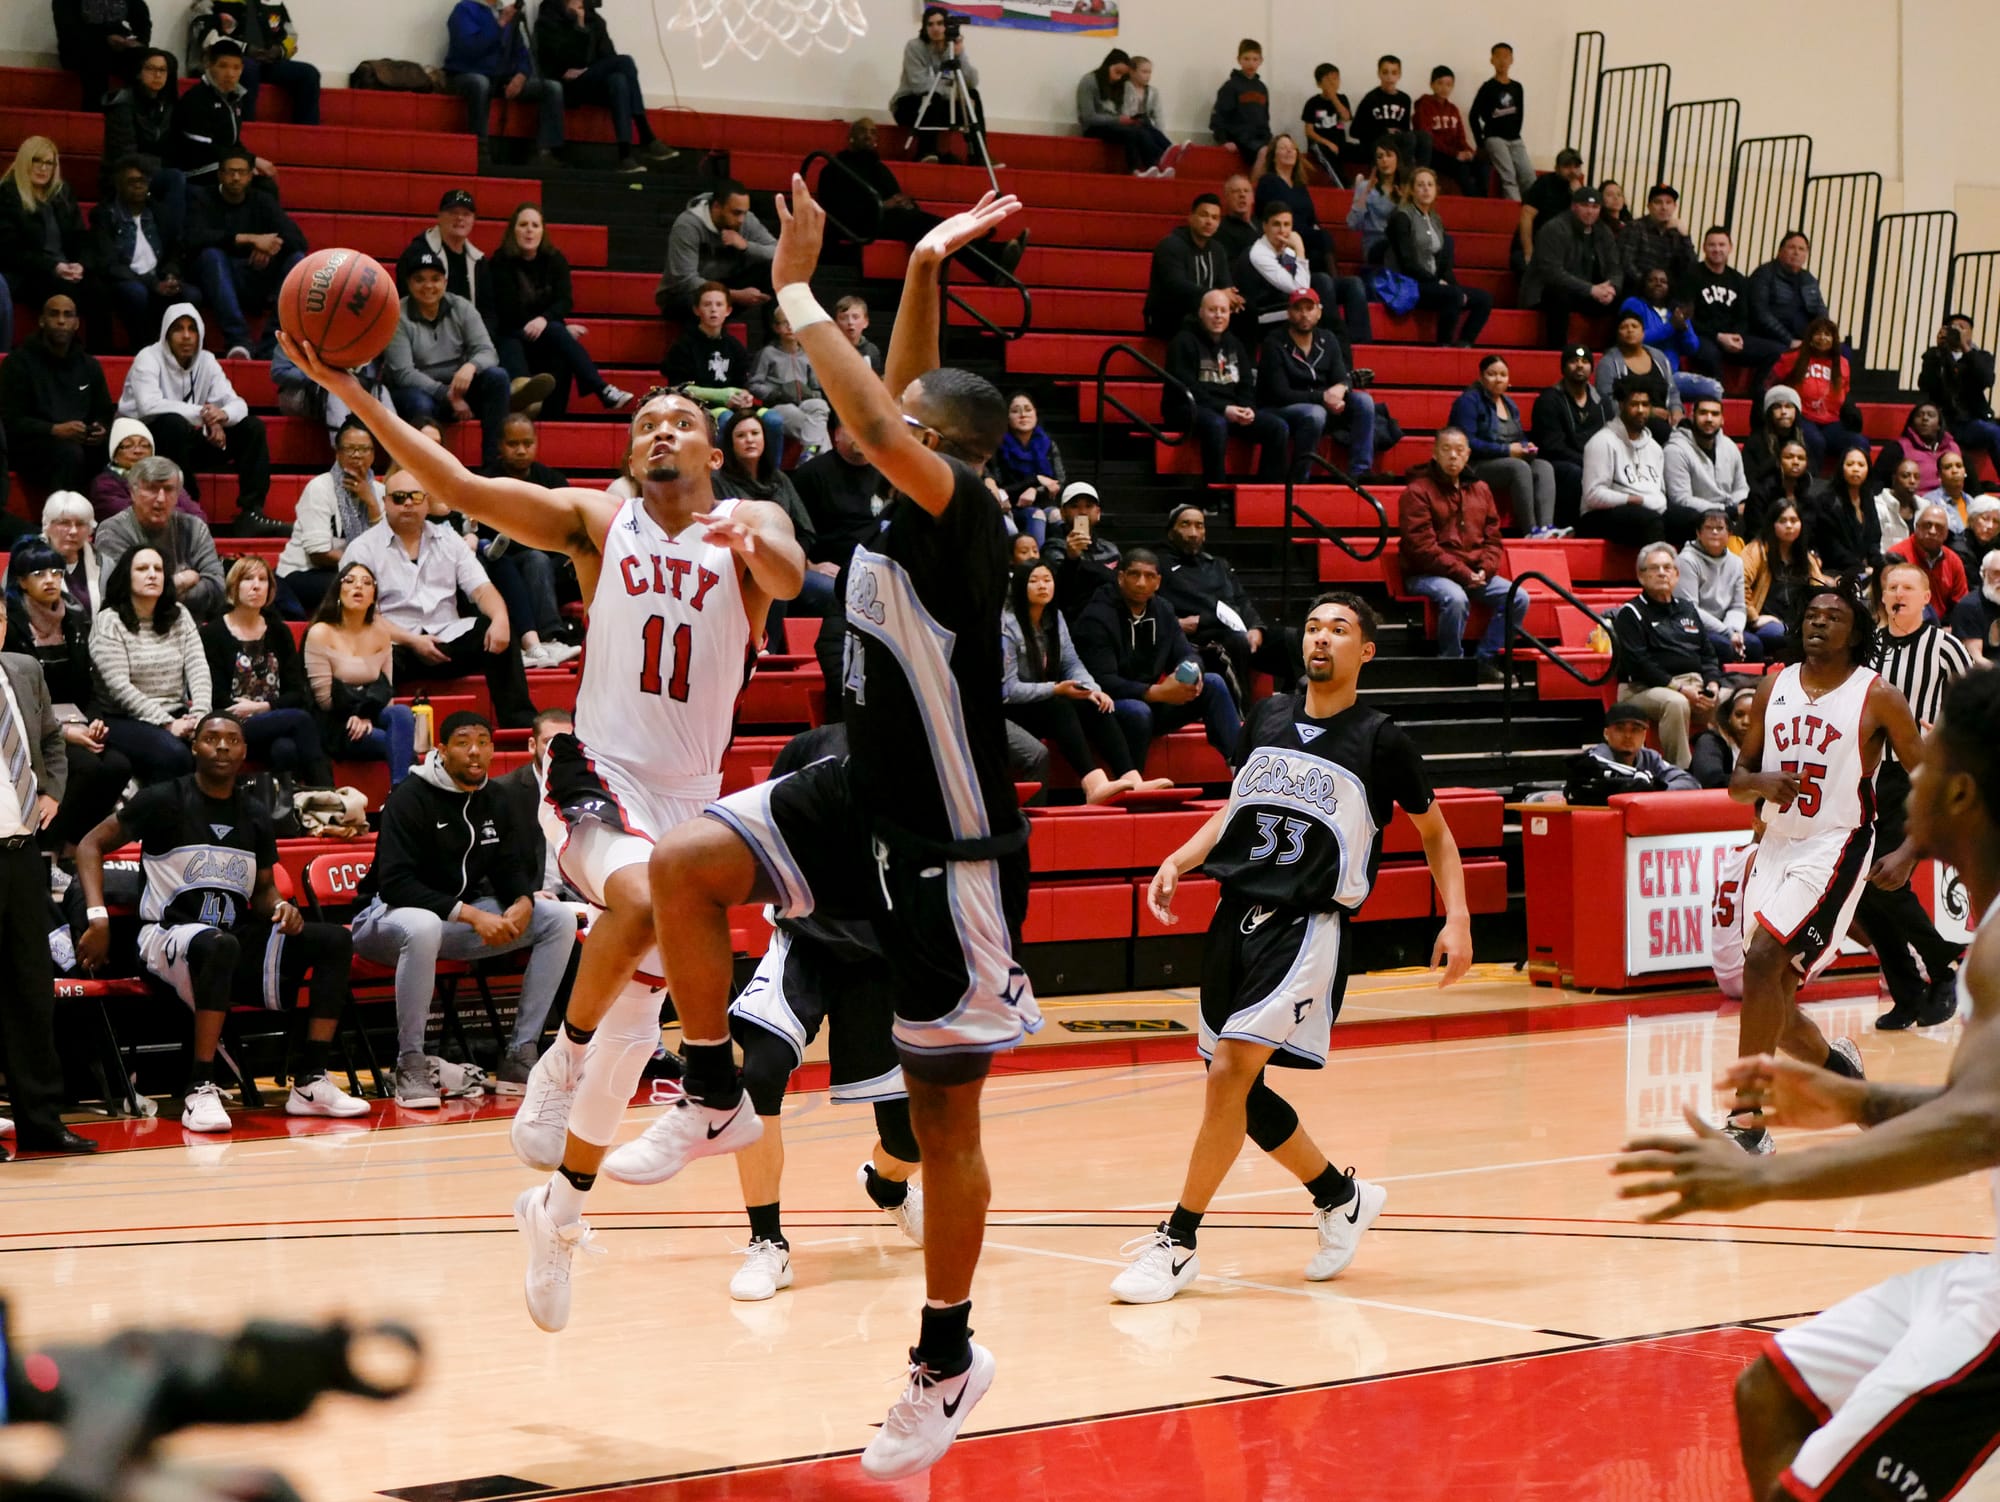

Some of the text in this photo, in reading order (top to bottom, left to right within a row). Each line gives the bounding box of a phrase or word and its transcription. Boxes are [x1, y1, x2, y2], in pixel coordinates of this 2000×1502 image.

[306, 250, 349, 313] Wilson
[346, 267, 377, 316] NCAA
[1701, 285, 1737, 307] CITY
[620, 554, 720, 612] CITY
[640, 614, 692, 703] 11
[1772, 714, 1843, 755] CITY
[1237, 755, 1338, 815] Cabrillo
[1249, 811, 1313, 865] 33
[327, 862, 372, 894] CCS
[1638, 846, 1703, 899] CITY
[1648, 905, 1704, 959] SAN
[1807, 926, 1825, 946] CITY
[59, 984, 85, 998] MS
[1876, 1456, 1928, 1502] CITY
